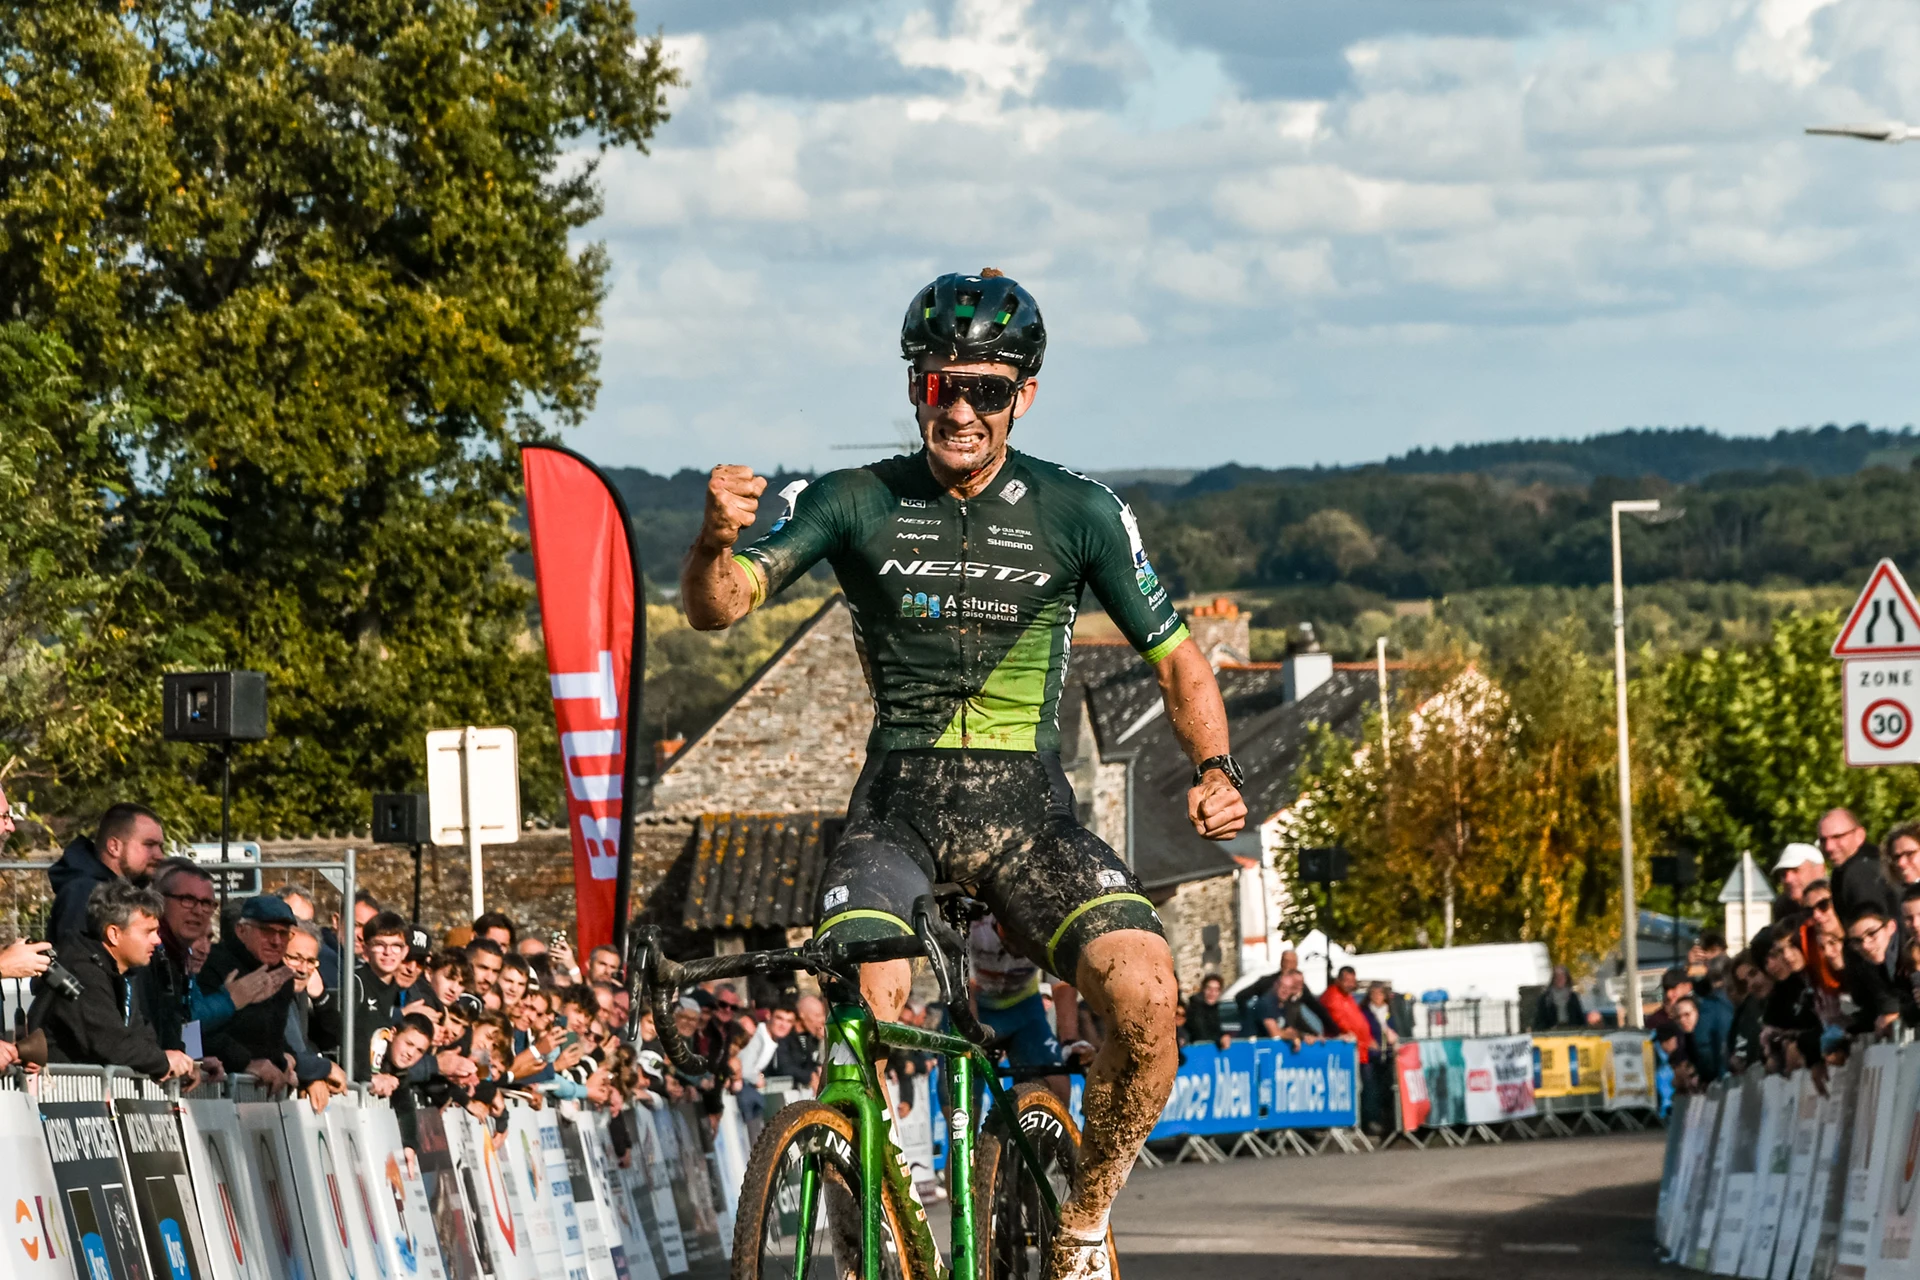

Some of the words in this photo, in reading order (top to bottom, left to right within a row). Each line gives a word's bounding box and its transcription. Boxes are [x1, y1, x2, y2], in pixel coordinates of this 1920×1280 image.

[987, 538, 1034, 551] SHIMANO
[878, 559, 1052, 587] NESTA
[985, 612, 1018, 623] natural
[1859, 669, 1914, 688] ZONE
[1872, 713, 1903, 735] 30
[549, 649, 623, 880] BUT
[1212, 1056, 1251, 1119] bleu
[1275, 1053, 1325, 1113] france
[1327, 1053, 1352, 1113] bleu
[1019, 1110, 1063, 1139] ESTA
